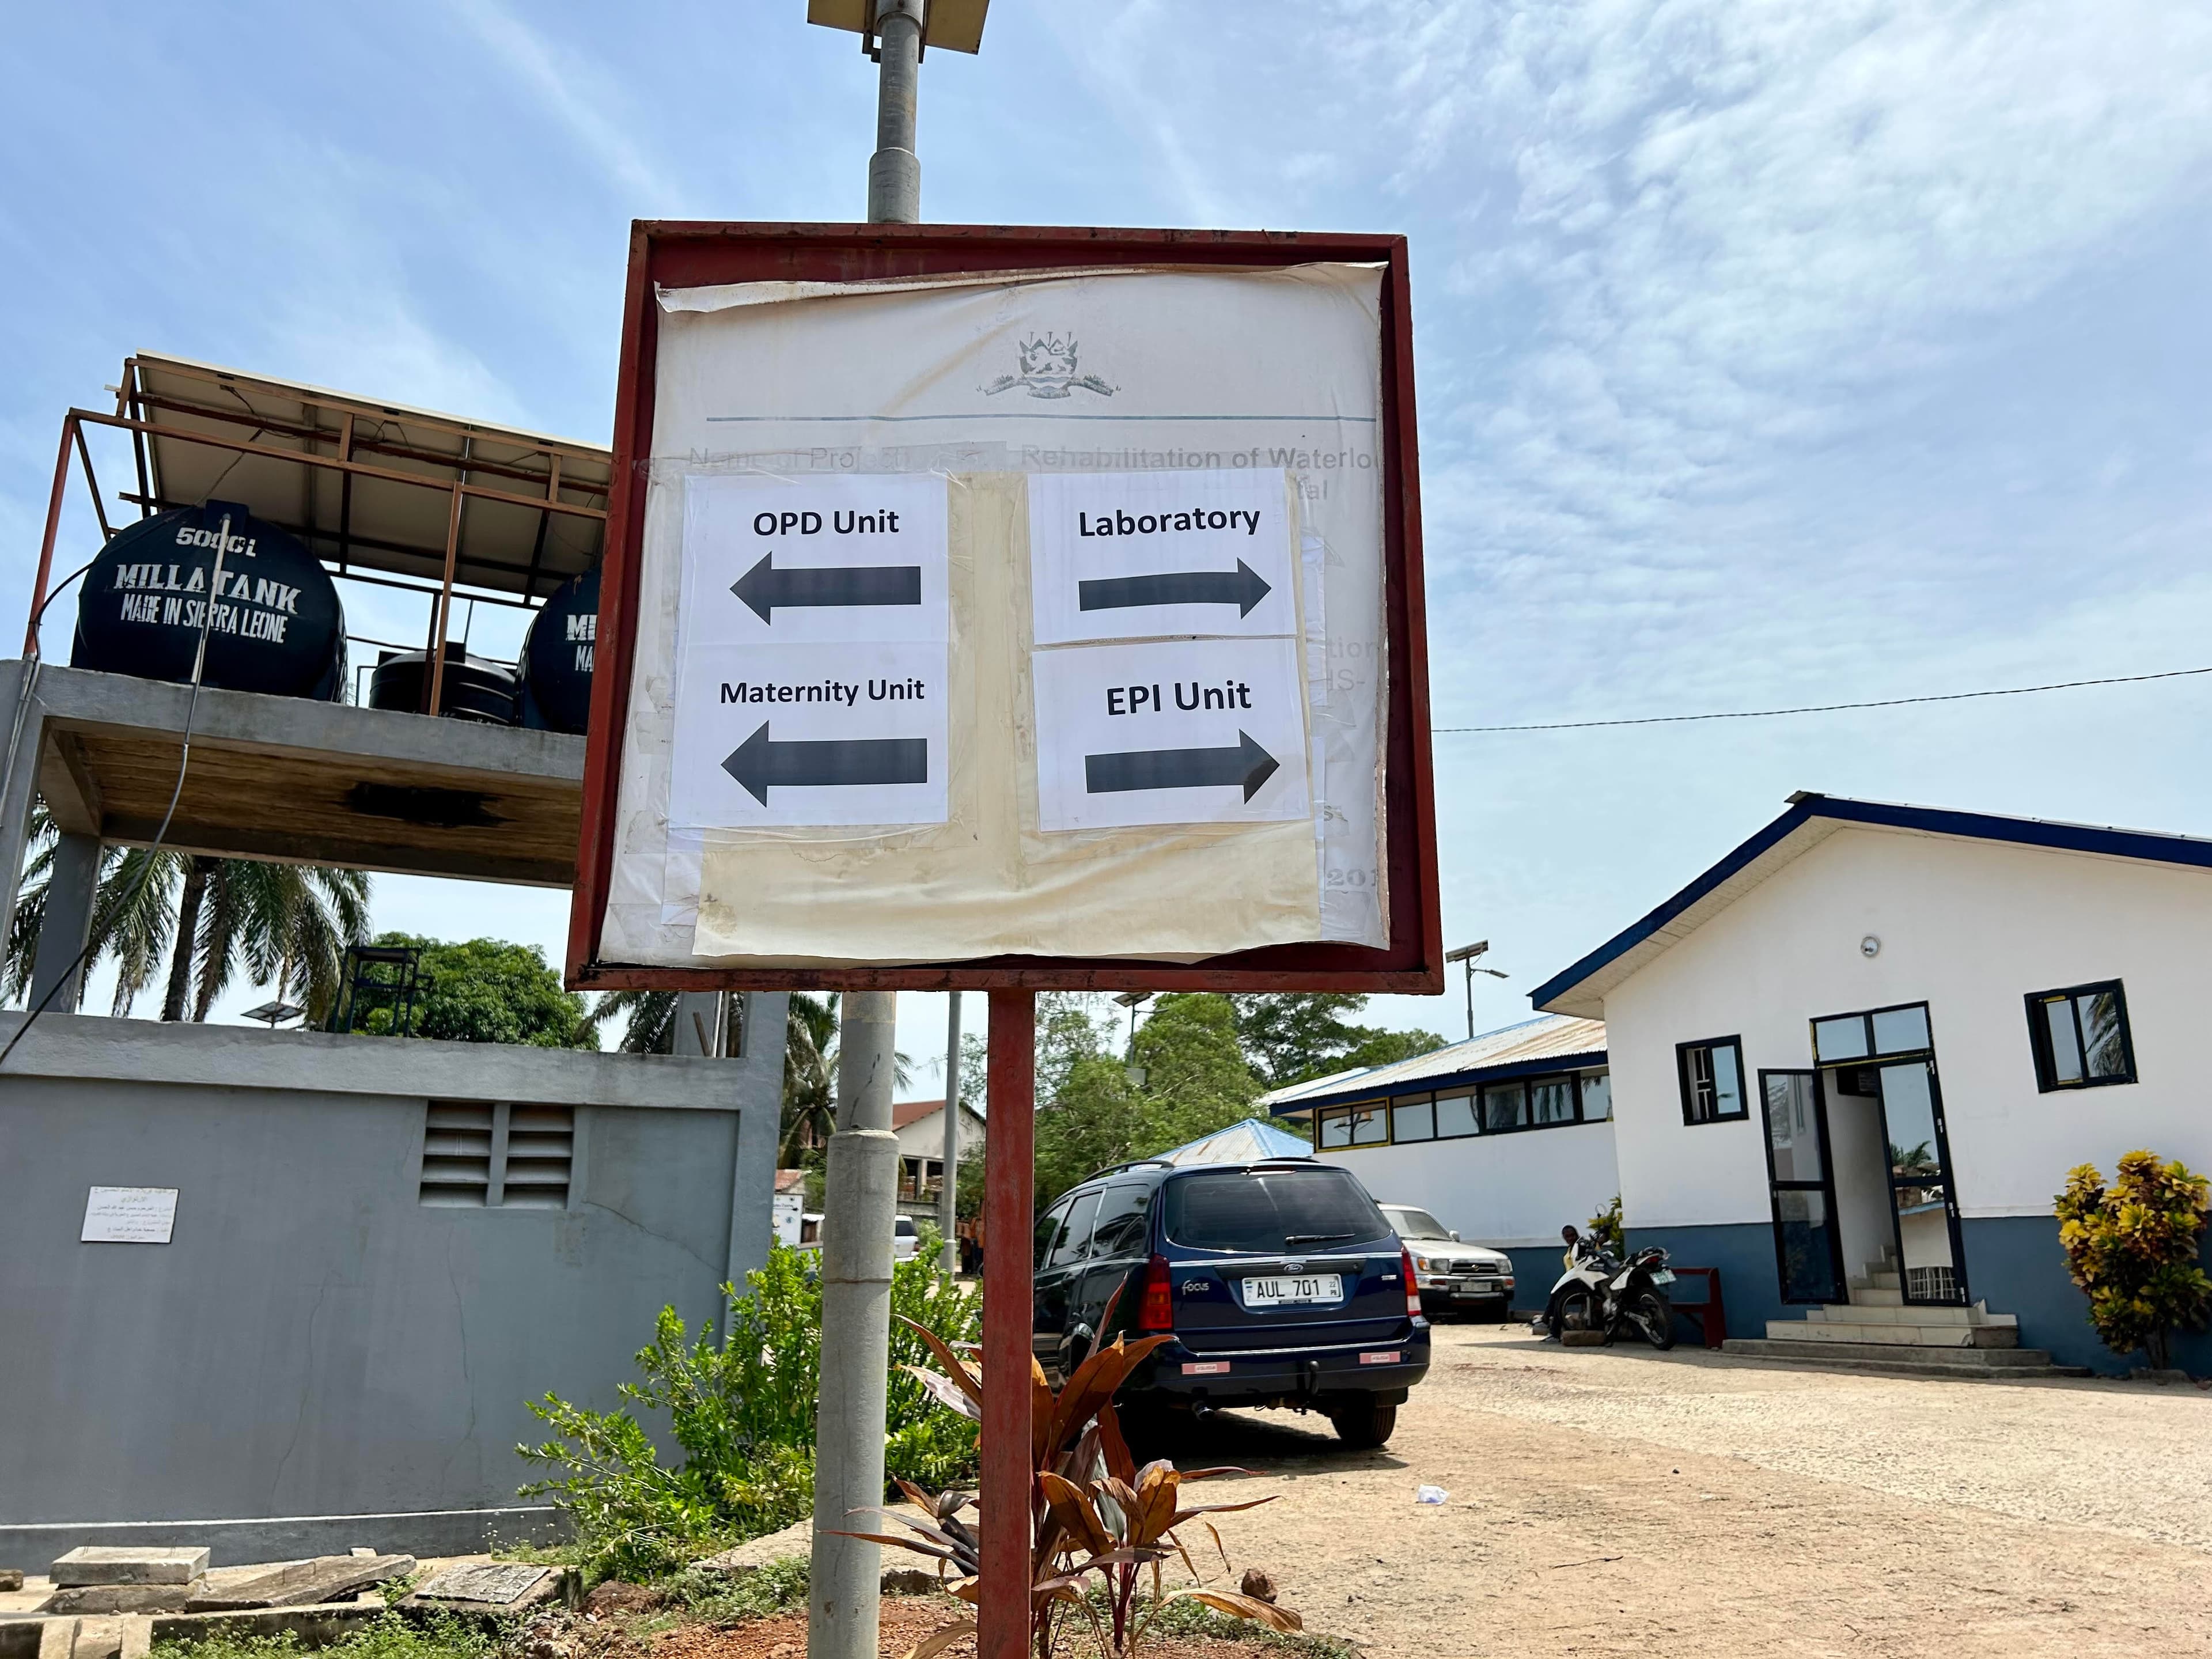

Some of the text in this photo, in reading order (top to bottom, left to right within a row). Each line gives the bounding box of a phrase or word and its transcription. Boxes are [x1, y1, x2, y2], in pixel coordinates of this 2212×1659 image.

[1022, 444, 1219, 468] Rehabilitation
[1232, 447, 1260, 468] of
[1268, 447, 1376, 469] Waterlo
[753, 509, 899, 536] OPD Unit
[1080, 508, 1260, 536] Laboratory
[113, 564, 301, 615] MILLA TANK
[120, 593, 288, 644] MADE IN SIERRA LEONE
[721, 678, 925, 706] Maternity Unit
[1107, 680, 1252, 715] EPI Unit
[1257, 1281, 1285, 1298] AUL
[1293, 1279, 1319, 1297] 701
